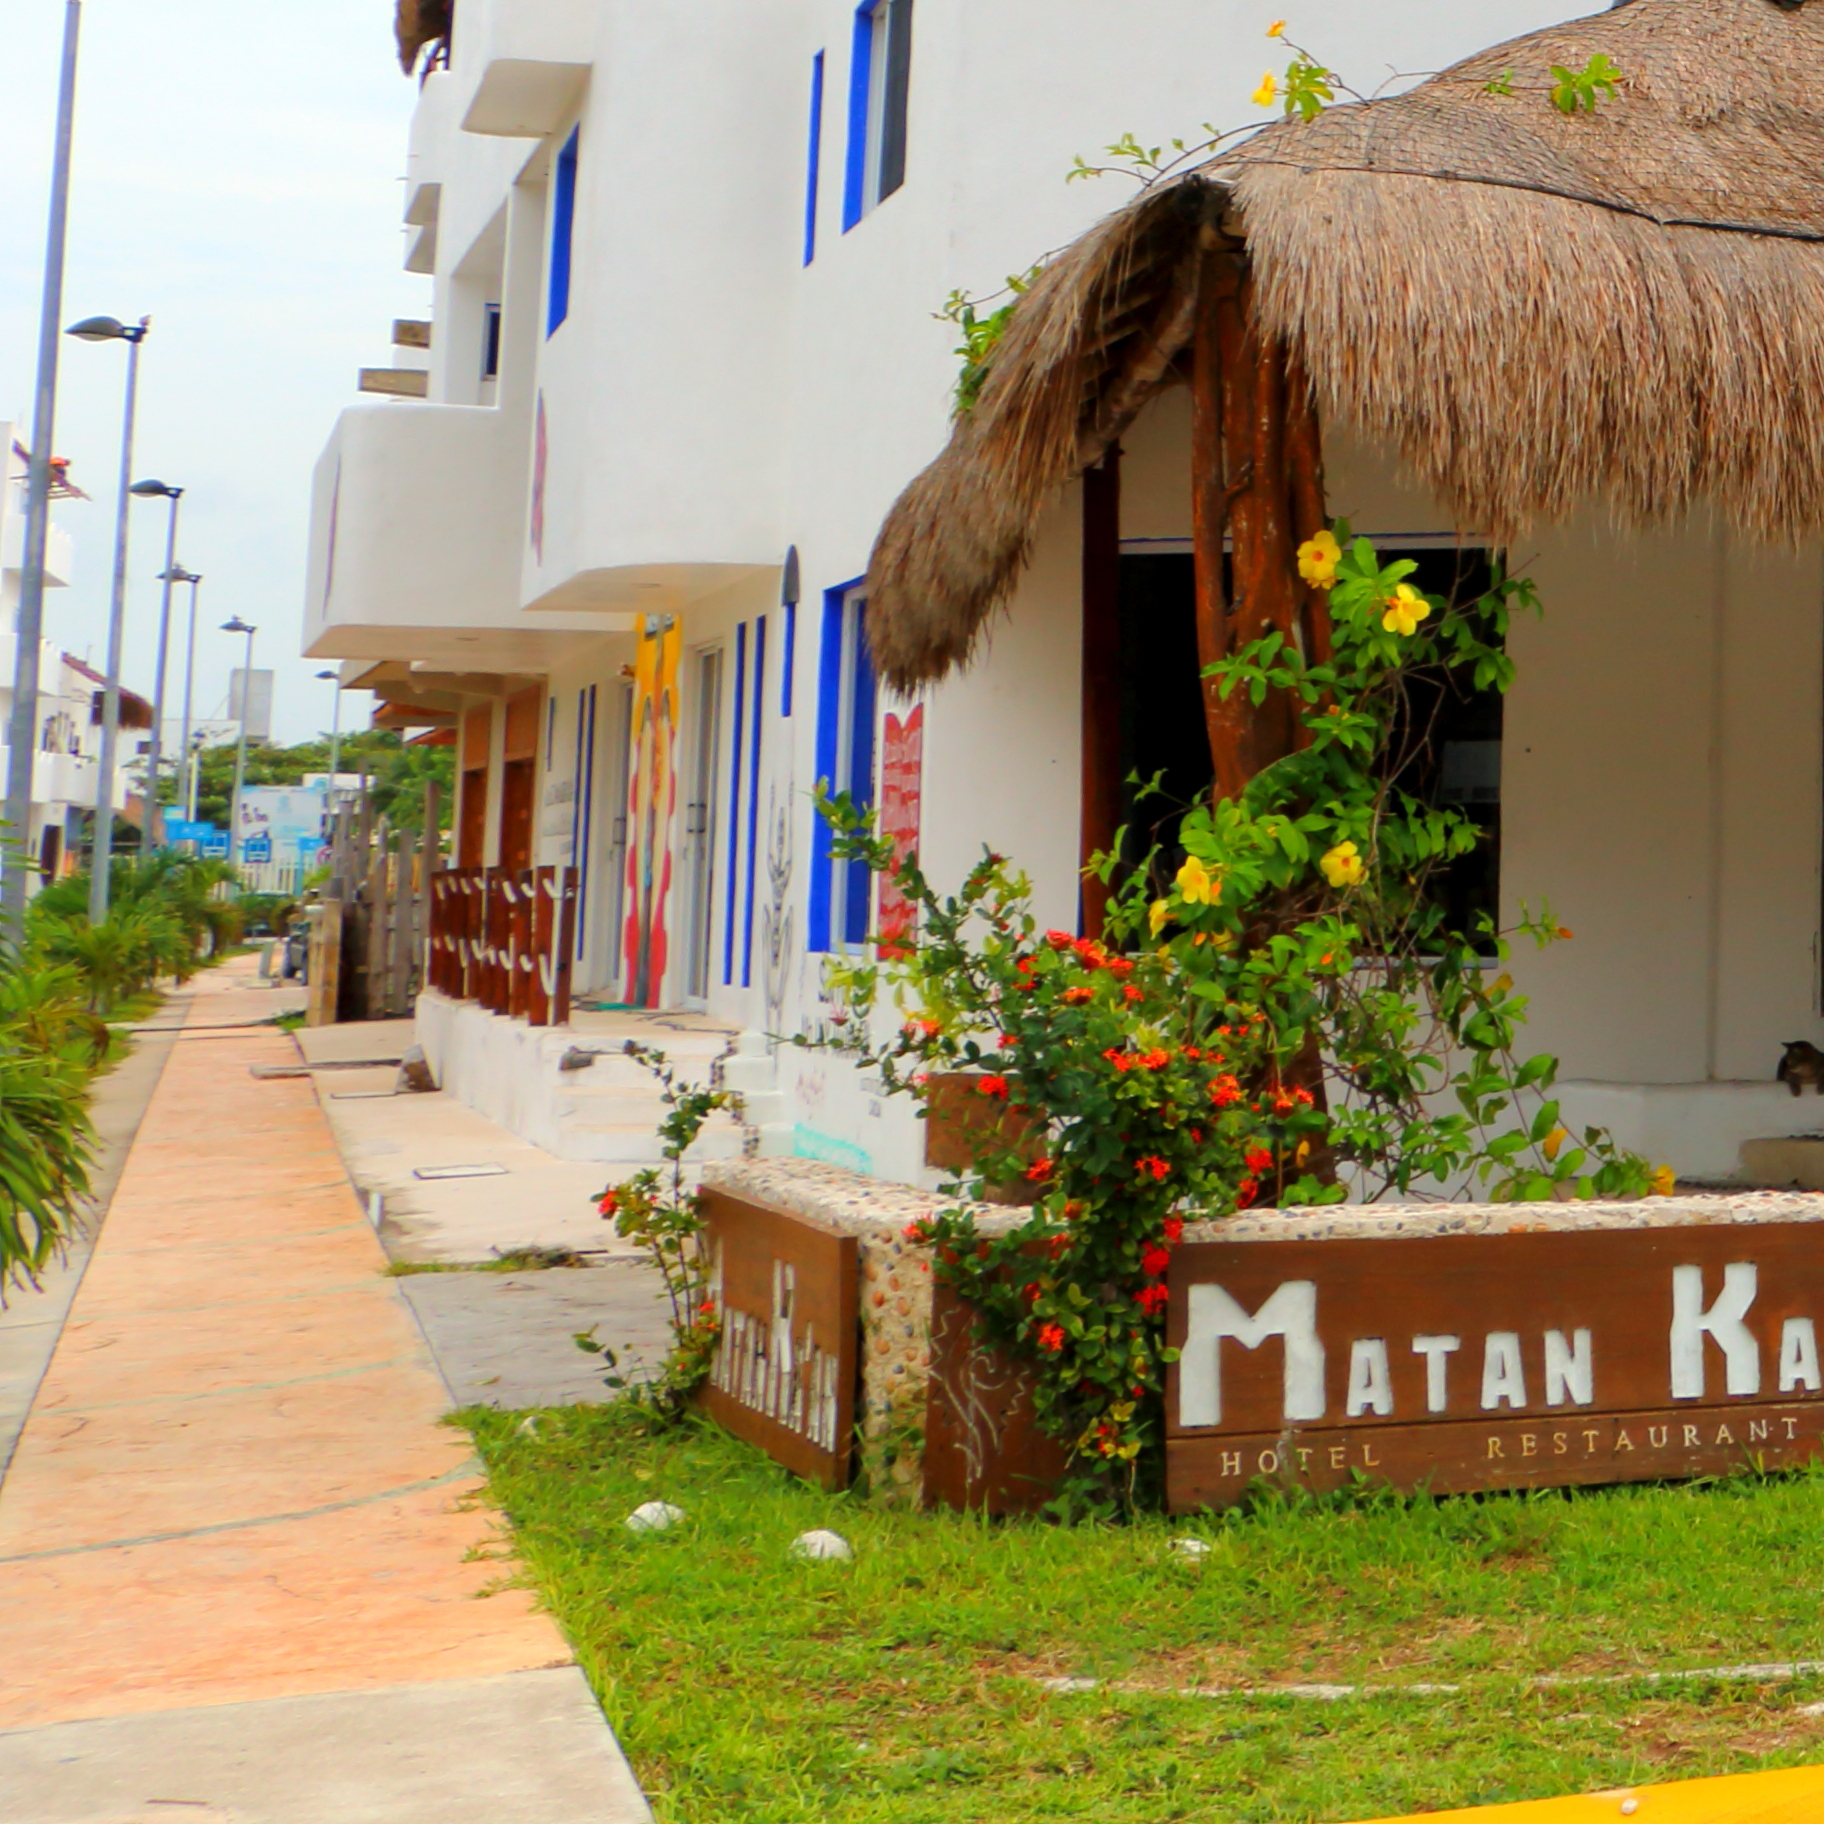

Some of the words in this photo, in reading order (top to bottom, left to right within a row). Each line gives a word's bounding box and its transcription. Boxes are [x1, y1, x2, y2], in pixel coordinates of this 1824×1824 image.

[1179, 1278, 1595, 1428] MATAN
[1219, 1443, 1382, 1477] HOTEL
[1486, 1416, 1799, 1460] RESTAURANT
